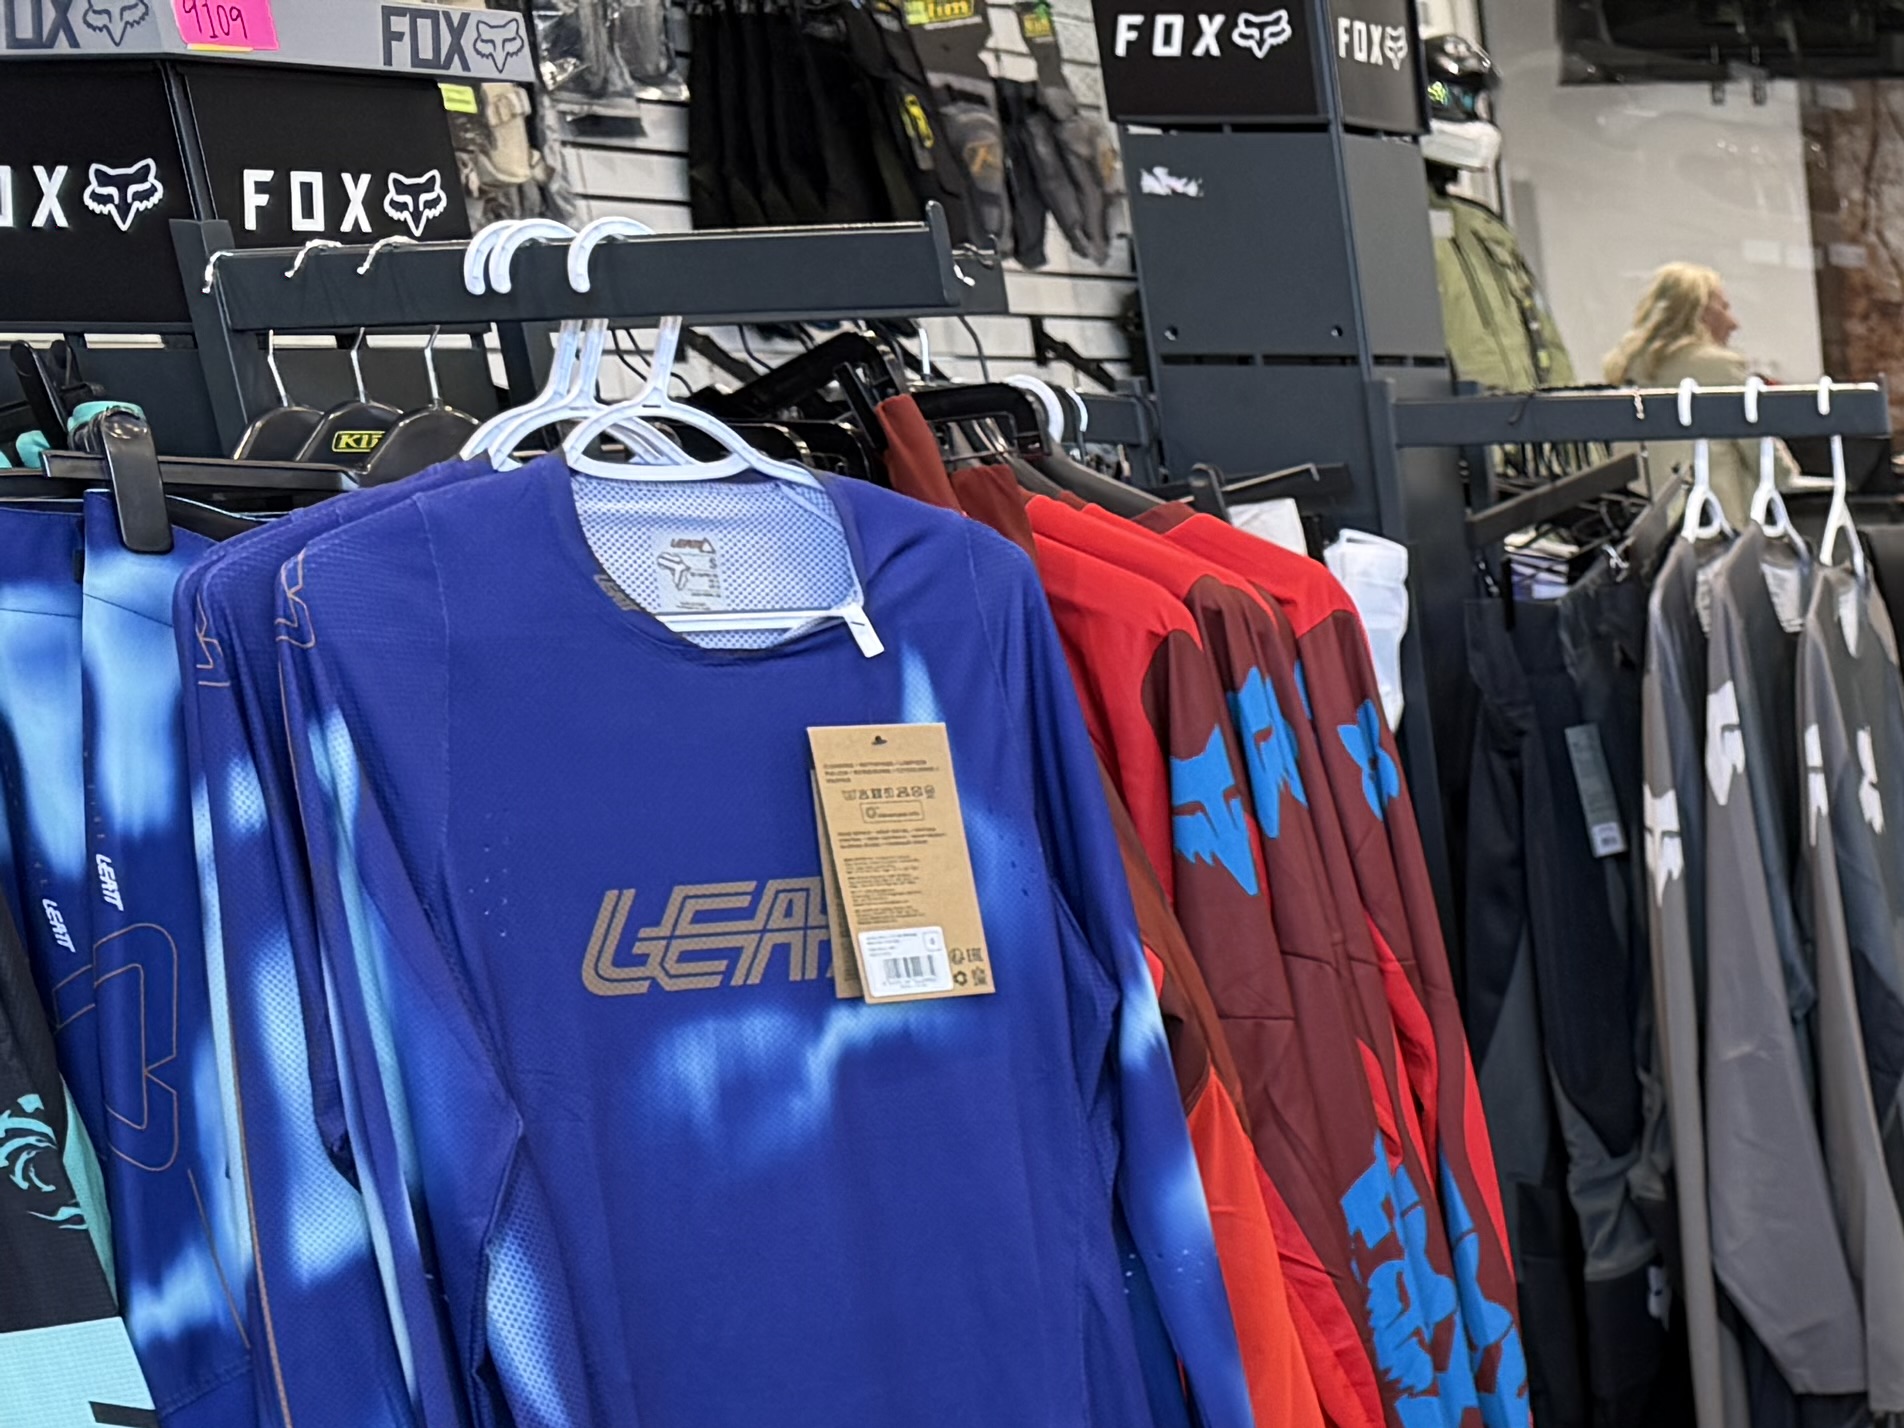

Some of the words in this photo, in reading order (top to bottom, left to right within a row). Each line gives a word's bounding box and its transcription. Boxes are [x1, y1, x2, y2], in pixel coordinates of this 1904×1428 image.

[4, 0, 81, 49] OX
[381, 5, 471, 72] FOX
[1115, 14, 1226, 58] FOX
[1338, 16, 1384, 66] FOX
[243, 168, 372, 233] FOX
[95, 852, 125, 912] LEATT
[581, 875, 833, 997] LEA
